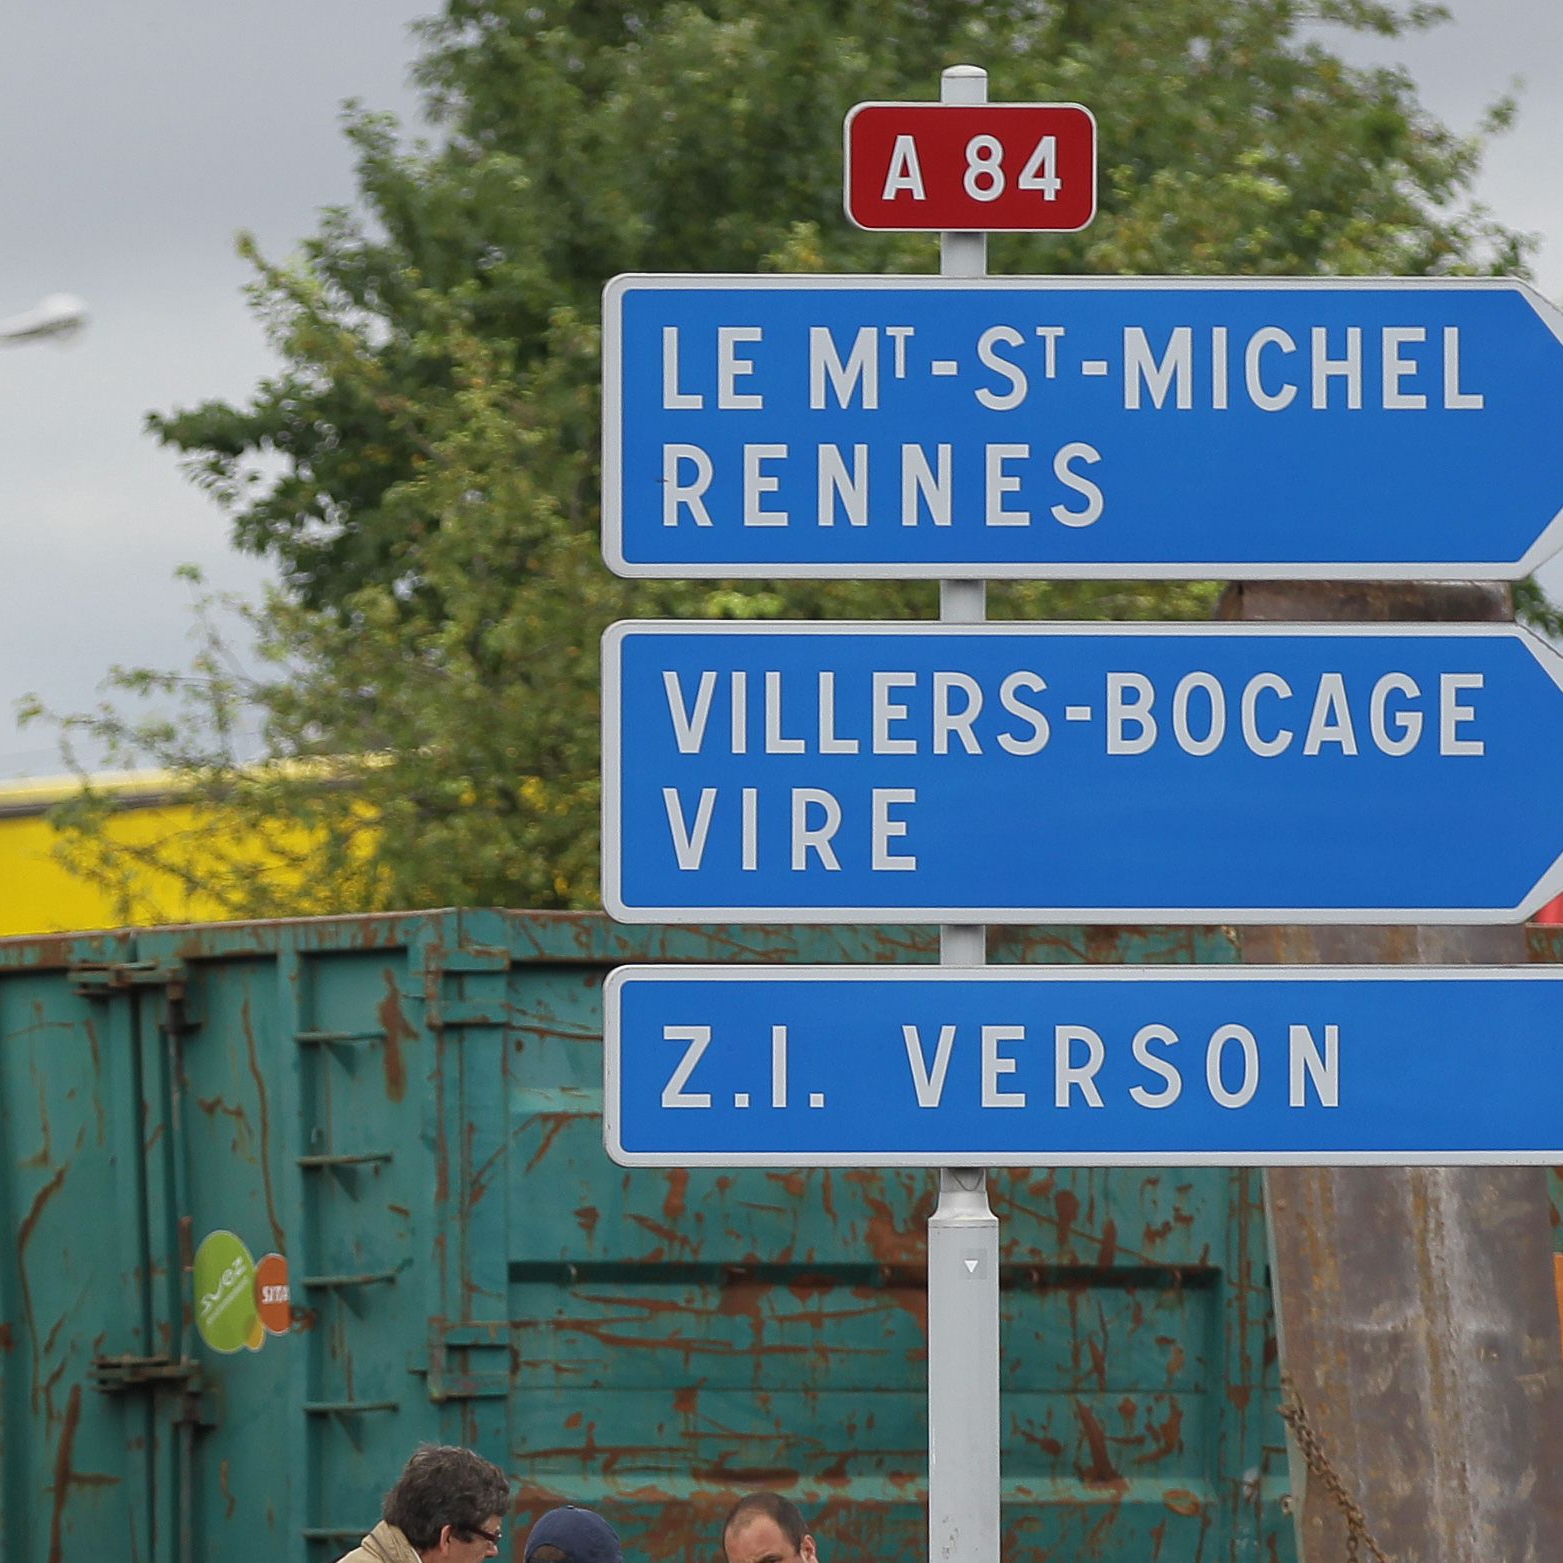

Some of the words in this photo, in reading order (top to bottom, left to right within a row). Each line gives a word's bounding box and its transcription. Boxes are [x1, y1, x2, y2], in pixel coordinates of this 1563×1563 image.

[883, 136, 925, 199] A
[964, 135, 1060, 201] 84
[664, 327, 762, 409] LE
[664, 443, 1103, 527] RENNES
[663, 672, 1483, 756] VILLERS-BOCAGE
[663, 788, 916, 870] VIRE
[662, 1026, 824, 1107] Z.I.
[903, 1024, 1338, 1108] VERSON
